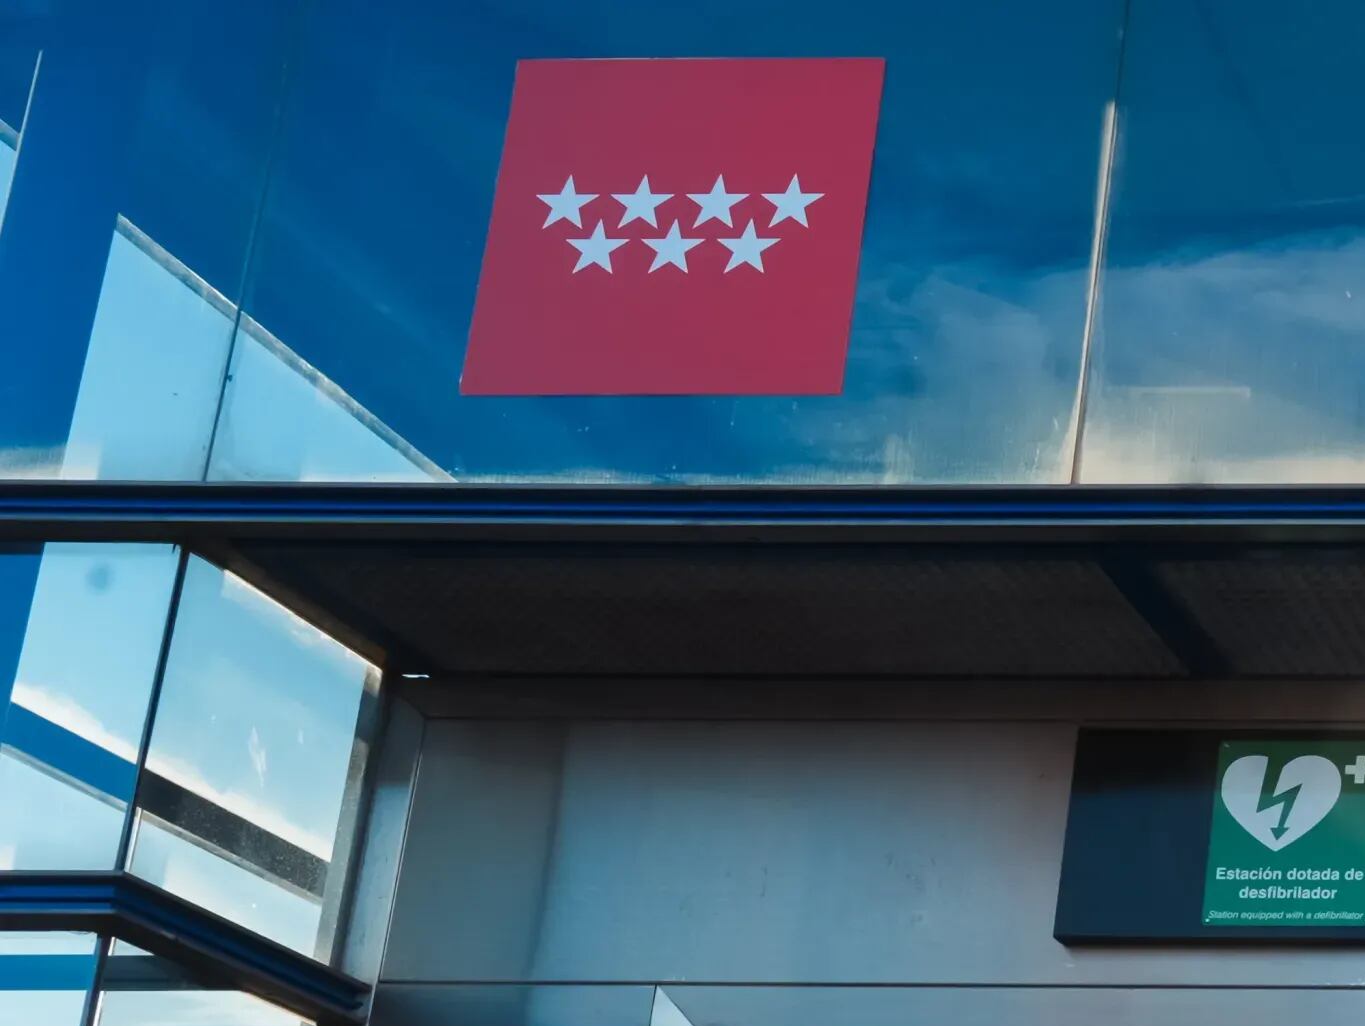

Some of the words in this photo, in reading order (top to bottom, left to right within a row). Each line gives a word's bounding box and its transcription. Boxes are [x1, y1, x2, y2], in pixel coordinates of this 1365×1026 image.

[1215, 867, 1282, 881] Estación
[1286, 867, 1340, 881] dotada
[1345, 867, 1364, 881] de
[1238, 886, 1338, 900] desfibrilador
[1208, 910, 1239, 920] Station
[1240, 911, 1284, 921] equipped
[1286, 911, 1304, 920] with
[1314, 911, 1364, 921] defibrillator
